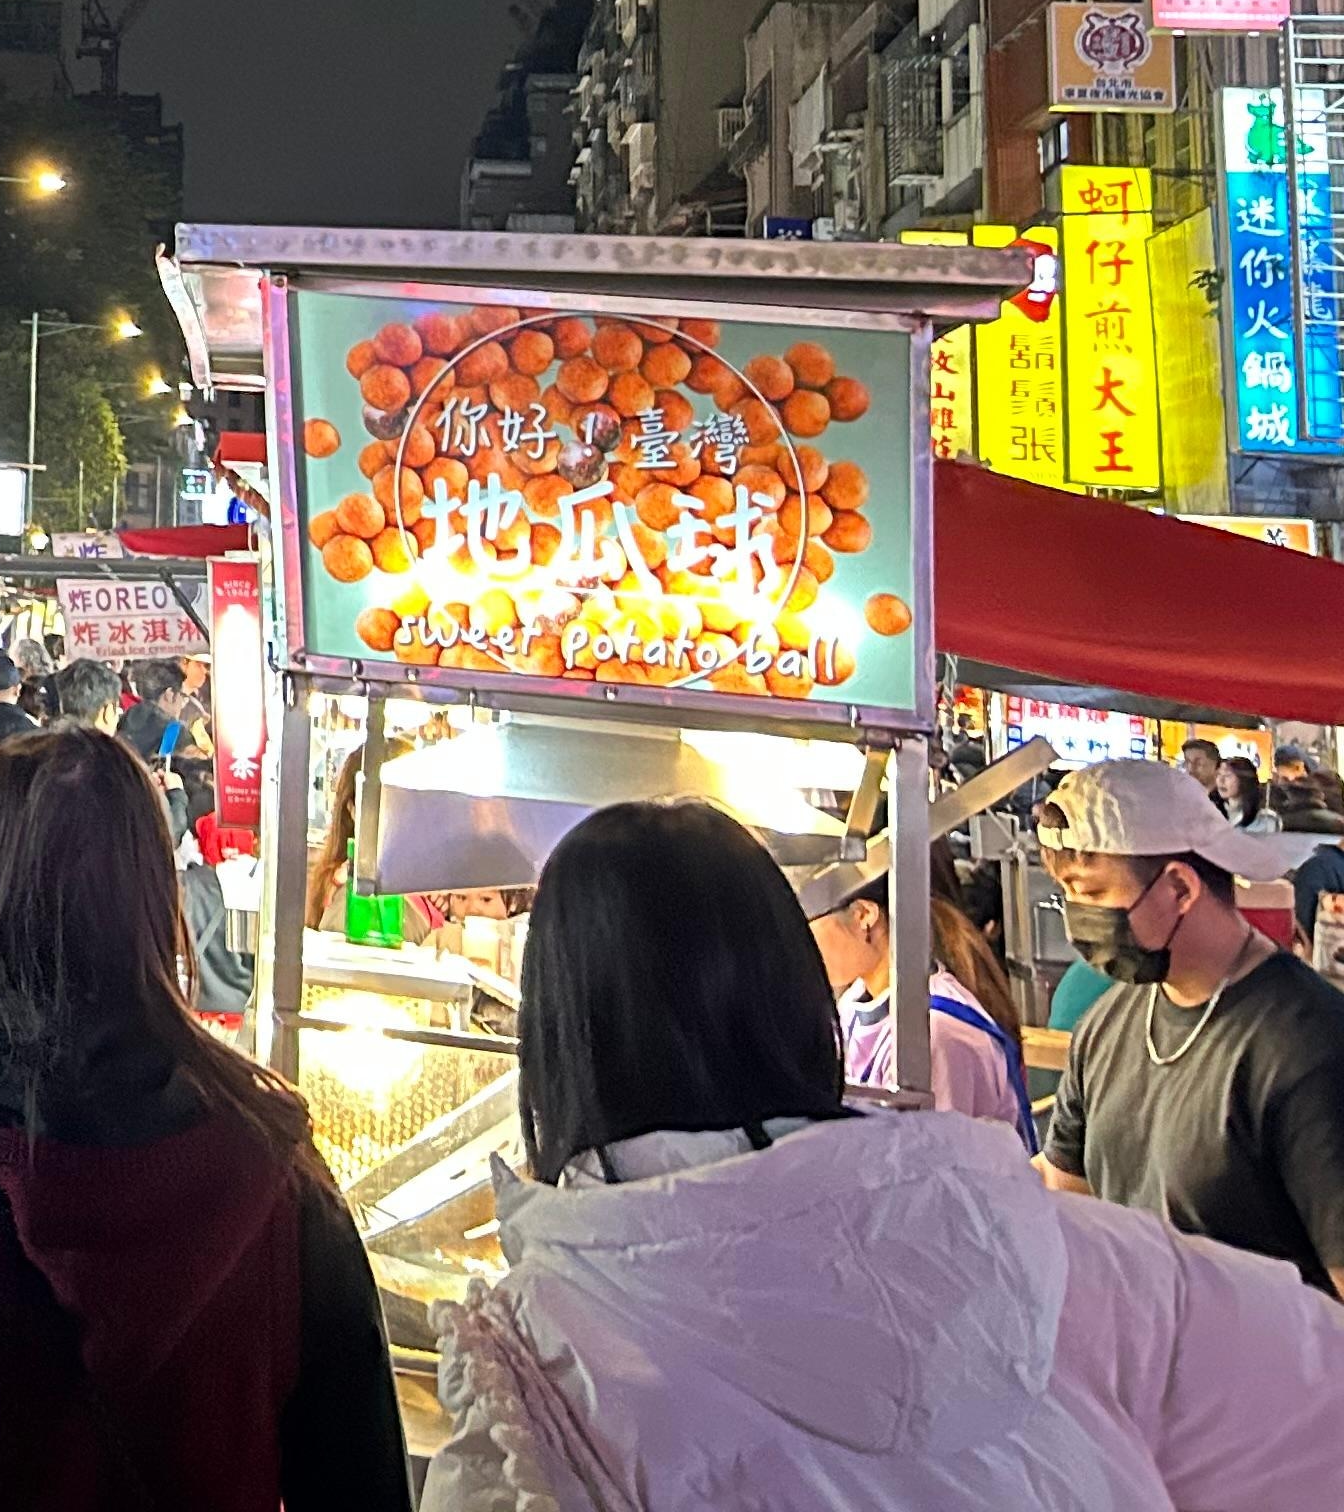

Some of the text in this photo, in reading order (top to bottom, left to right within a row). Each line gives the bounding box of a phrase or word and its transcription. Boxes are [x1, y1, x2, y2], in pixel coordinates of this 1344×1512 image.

[1078, 178, 1138, 474] 蚵仔煎大王
[1235, 194, 1296, 448] 迷你火鍋城
[1009, 334, 1057, 463] 鬍鬚張
[419, 472, 780, 598] 地瓜球
[398, 615, 838, 683] sweet potato ball
